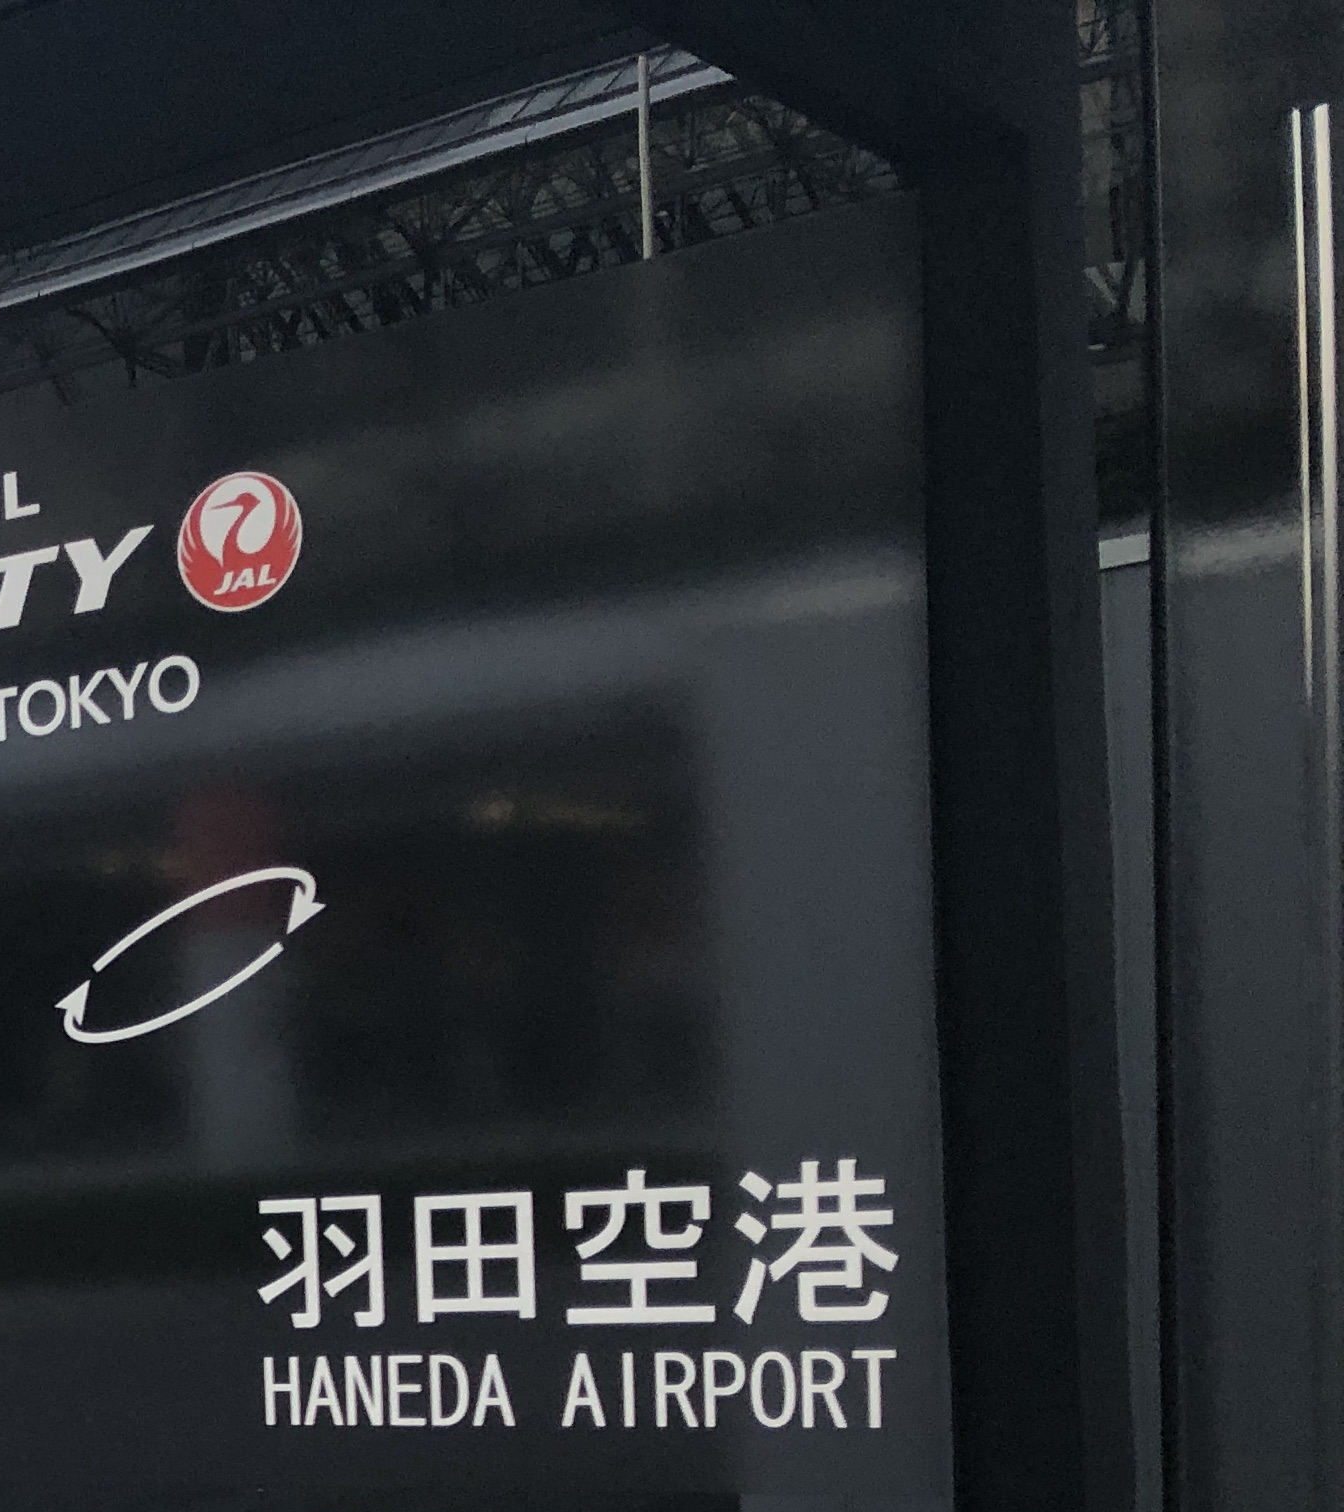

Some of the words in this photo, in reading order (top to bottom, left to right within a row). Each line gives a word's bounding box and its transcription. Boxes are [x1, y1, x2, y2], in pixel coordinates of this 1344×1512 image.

[213, 563, 277, 596] JAL
[258, 1159, 898, 1328] 羽田空港
[264, 1354, 515, 1426] HANEDA
[562, 1350, 896, 1428] AIRPORT
